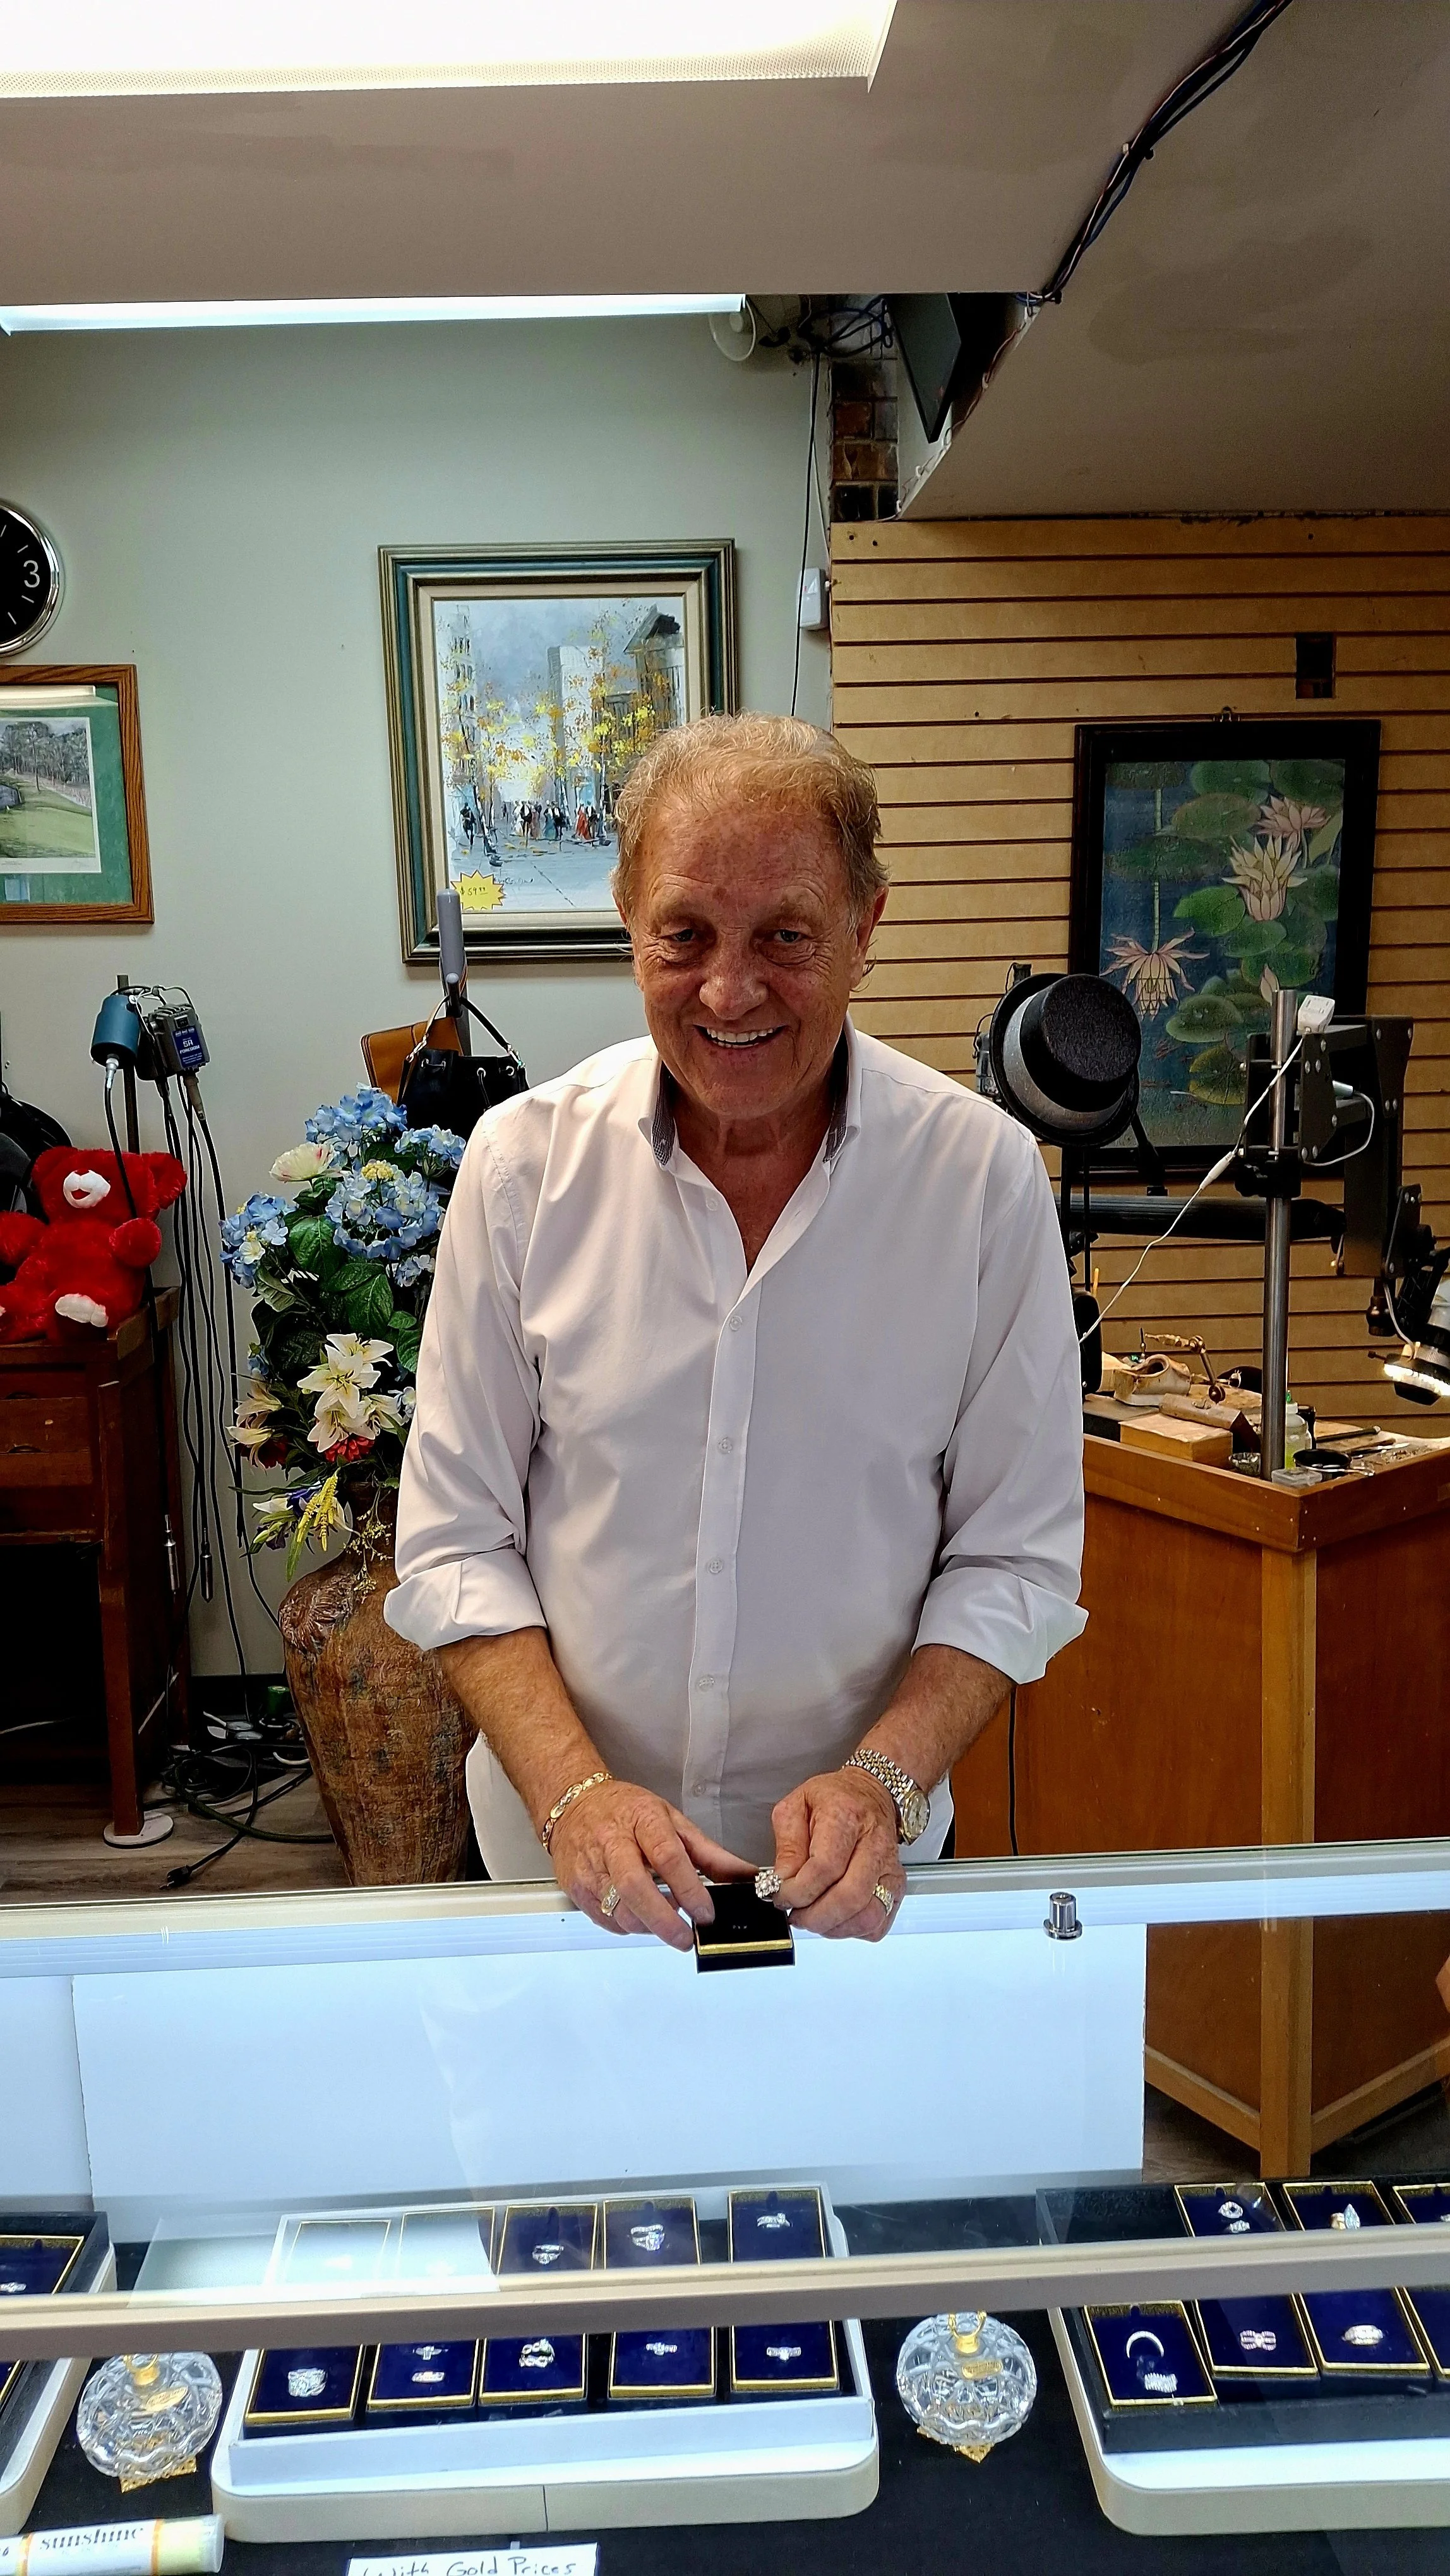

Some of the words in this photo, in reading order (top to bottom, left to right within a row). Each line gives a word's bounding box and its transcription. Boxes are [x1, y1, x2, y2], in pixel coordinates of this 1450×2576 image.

[23, 560, 40, 588] 3
[40, 2528, 144, 2550] sunshine
[446, 2555, 498, 2576] Gold
[507, 2556, 576, 2575] Prices
